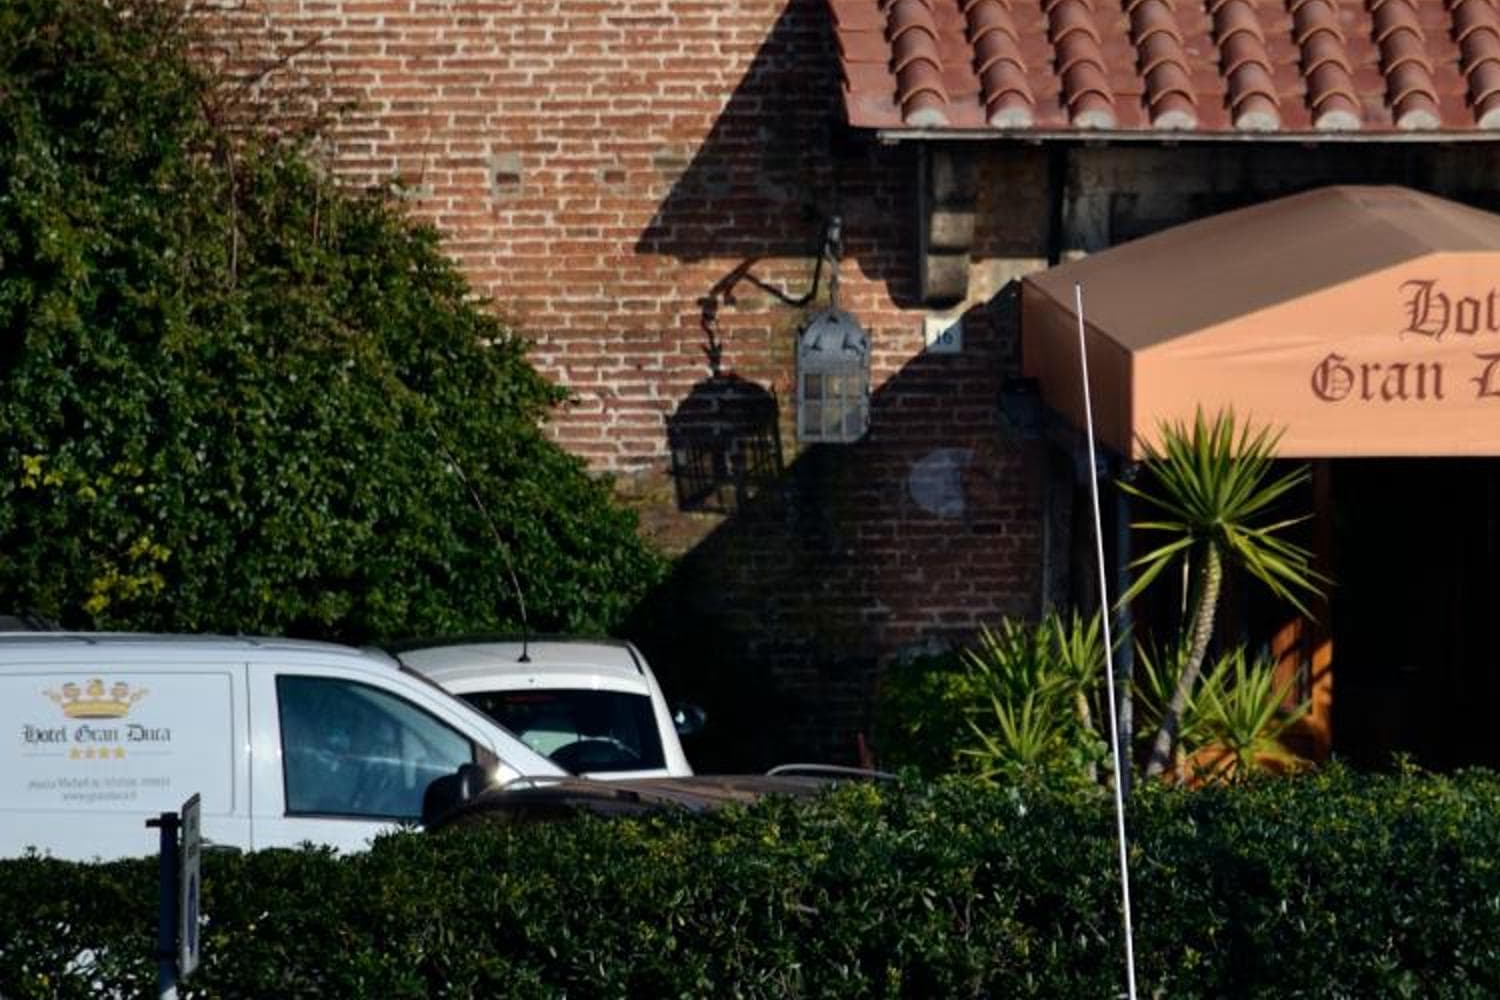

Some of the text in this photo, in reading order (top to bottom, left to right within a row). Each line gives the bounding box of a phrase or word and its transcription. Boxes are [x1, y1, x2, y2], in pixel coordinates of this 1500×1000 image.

[1310, 351, 1444, 403] Gran
[22, 723, 171, 744] Hotel Gran Duca
